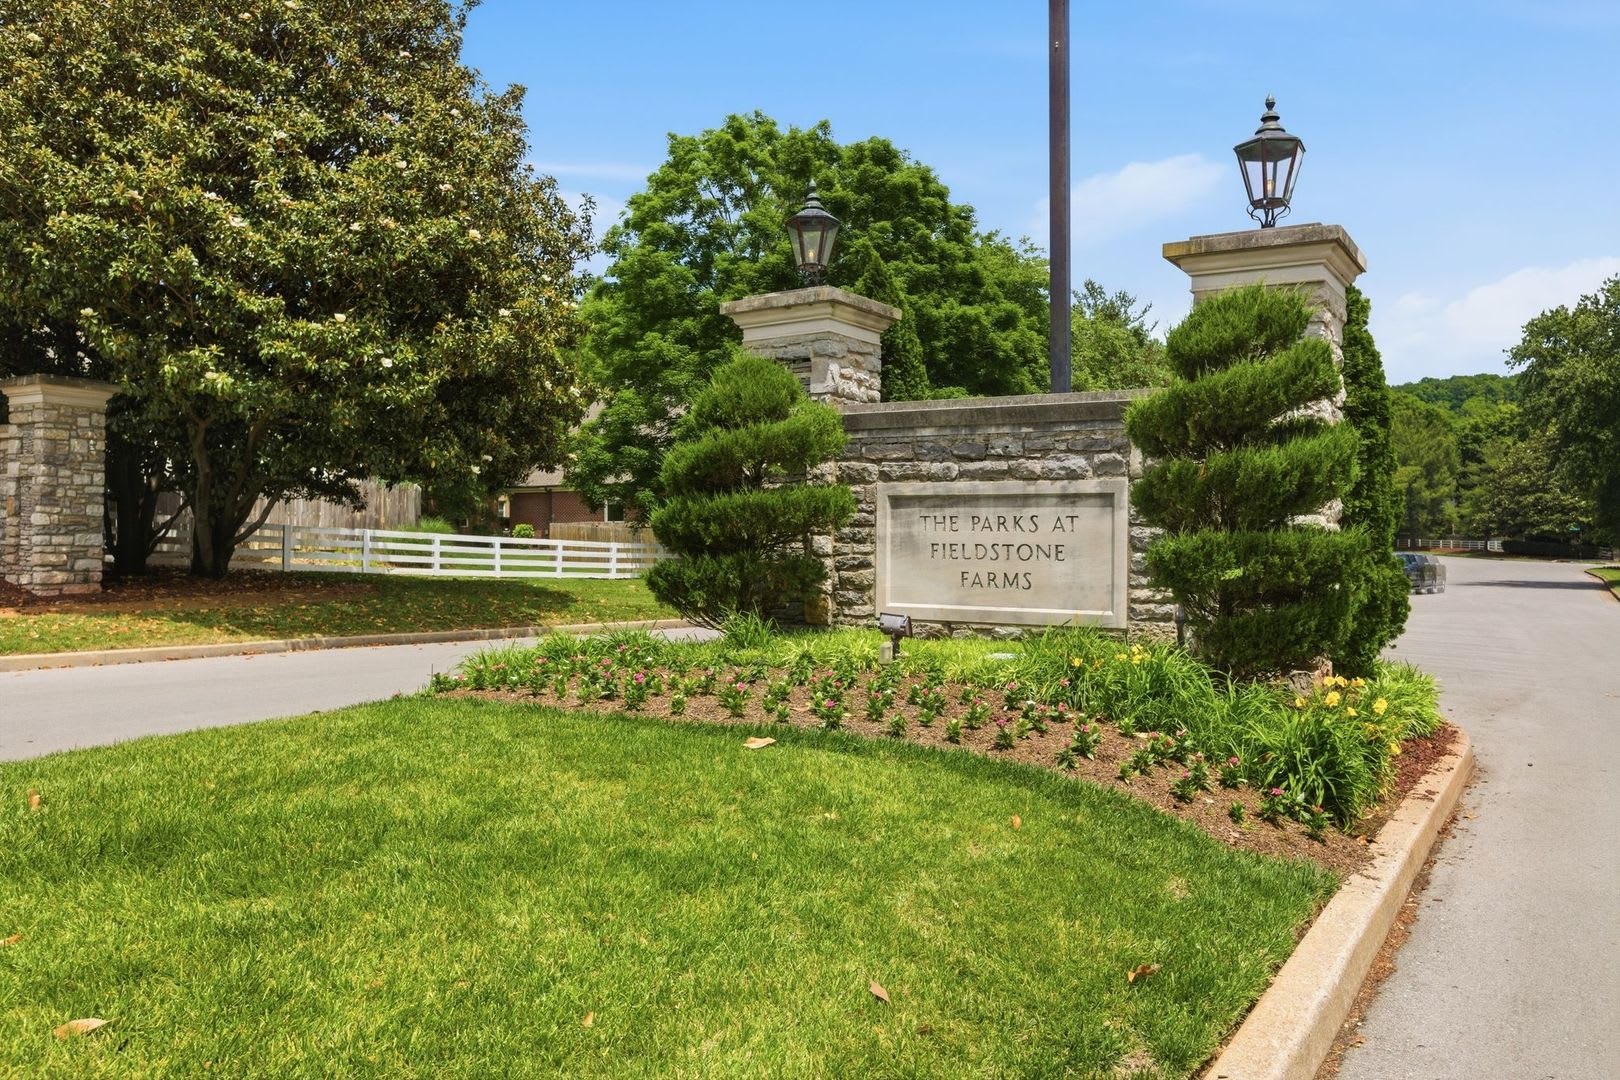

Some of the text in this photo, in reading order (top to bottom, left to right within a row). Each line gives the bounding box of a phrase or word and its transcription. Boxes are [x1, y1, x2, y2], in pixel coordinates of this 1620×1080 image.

[919, 514, 1079, 533] THE PARKS AT
[930, 543, 1065, 562] FIELDSTONE
[960, 571, 1032, 590] FARMS
